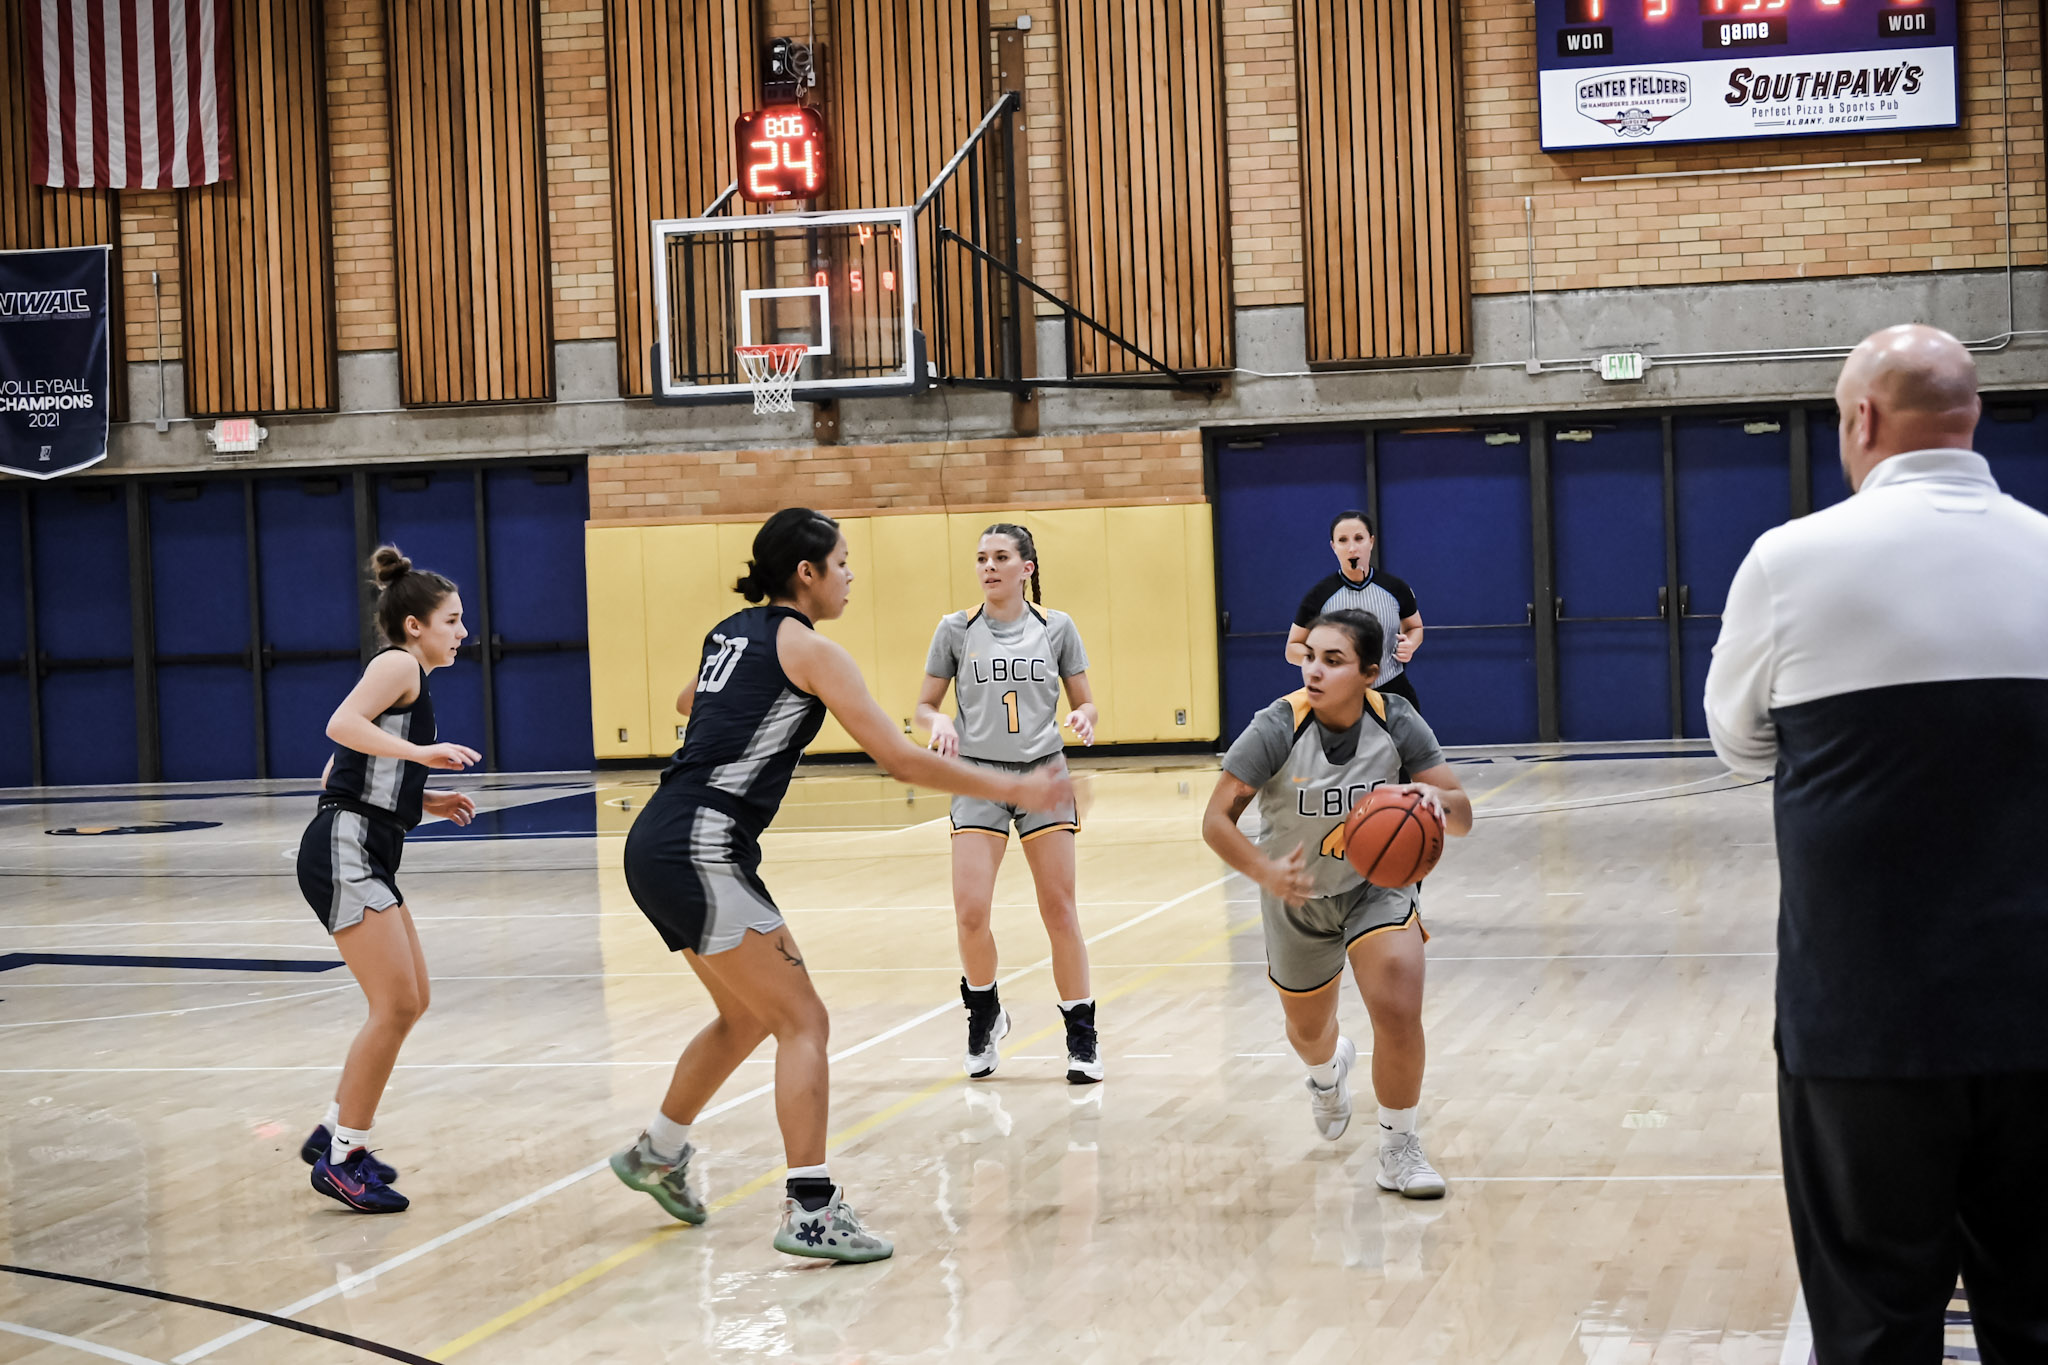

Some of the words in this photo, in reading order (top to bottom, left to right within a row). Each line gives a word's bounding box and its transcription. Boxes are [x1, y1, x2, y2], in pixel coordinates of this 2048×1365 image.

[1889, 13, 1926, 32] won
[1567, 33, 1603, 51] won
[1720, 22, 1769, 46] game
[1580, 80, 1626, 99] CENTER
[1724, 61, 1923, 107] SOUTHPAW'S
[1752, 106, 1791, 118] Perfect
[1797, 104, 1824, 116] Pizza
[1840, 101, 1875, 114] Sports
[1880, 99, 1899, 111] Pub
[1829, 115, 1865, 124] OREGON
[749, 139, 814, 194] 24
[28, 412, 60, 428] 2021
[222, 420, 251, 443] EXIT
[971, 656, 1046, 686] LBCC
[1001, 690, 1020, 733] 1
